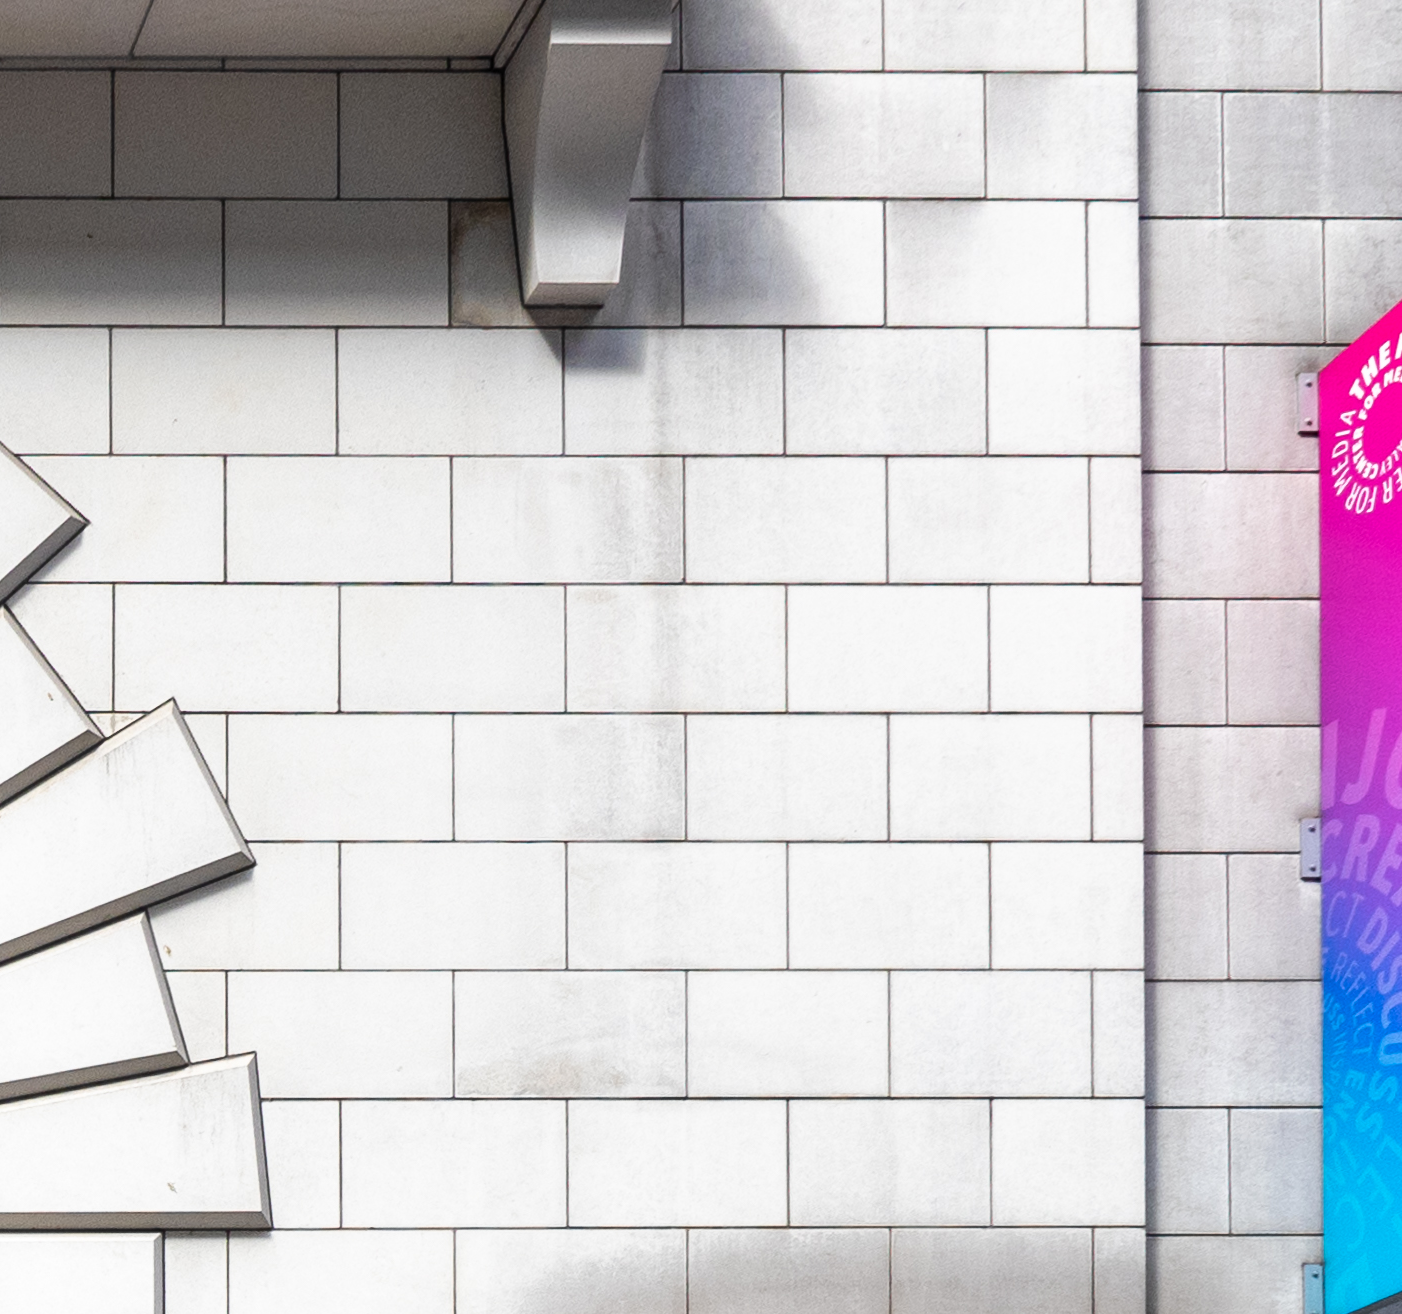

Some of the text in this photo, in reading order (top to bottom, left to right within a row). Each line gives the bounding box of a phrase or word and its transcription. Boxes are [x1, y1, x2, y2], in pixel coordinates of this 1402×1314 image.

[1349, 340, 1391, 400] THE
[1358, 382, 1382, 421] FOR
[1331, 409, 1357, 496] MEDIA
